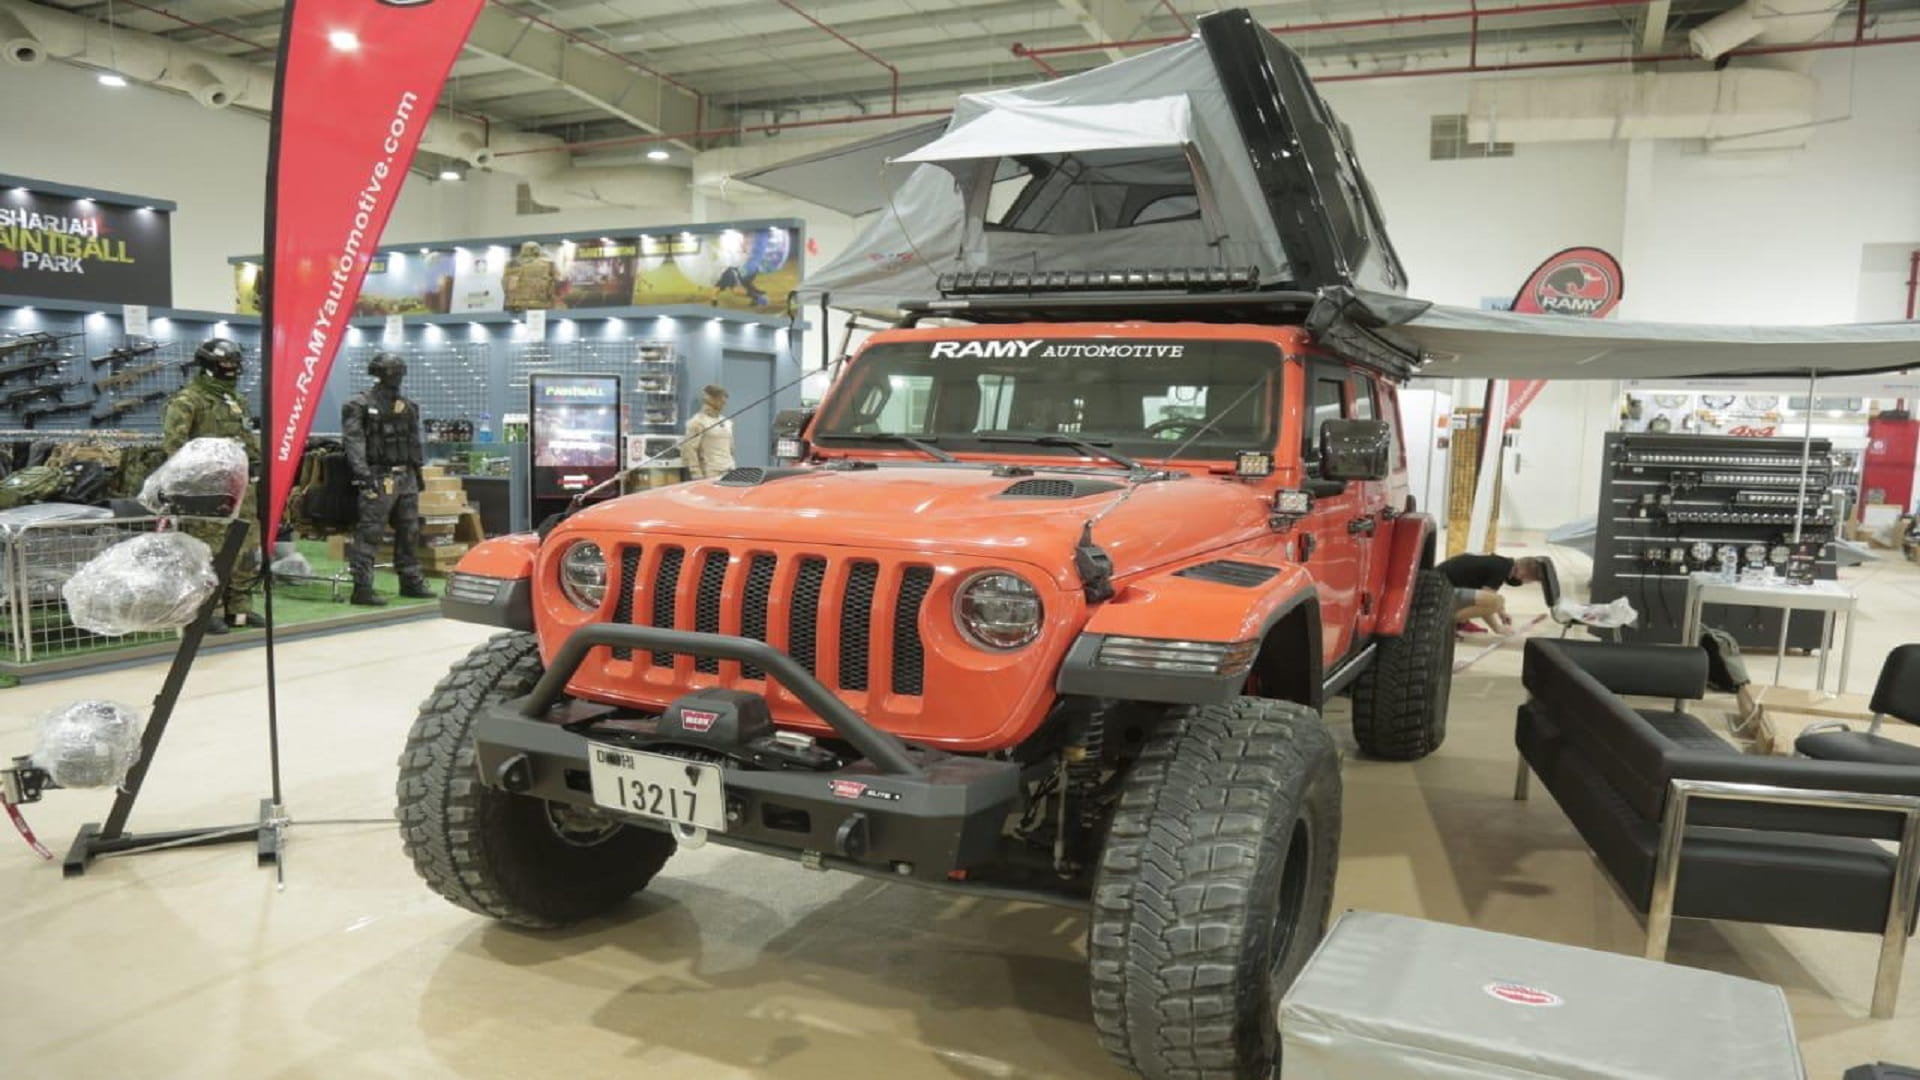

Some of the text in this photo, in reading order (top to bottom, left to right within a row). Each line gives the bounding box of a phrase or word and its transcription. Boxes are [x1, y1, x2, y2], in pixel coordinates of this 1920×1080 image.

[0, 207, 98, 238] SHARJAH
[22, 251, 85, 272] PARK
[278, 90, 418, 462] www.RAMYautomotive.com
[1542, 296, 1603, 311] RAMY
[929, 339, 1186, 359] RAMY AUTOMOTIVE
[617, 776, 697, 823] 13217
